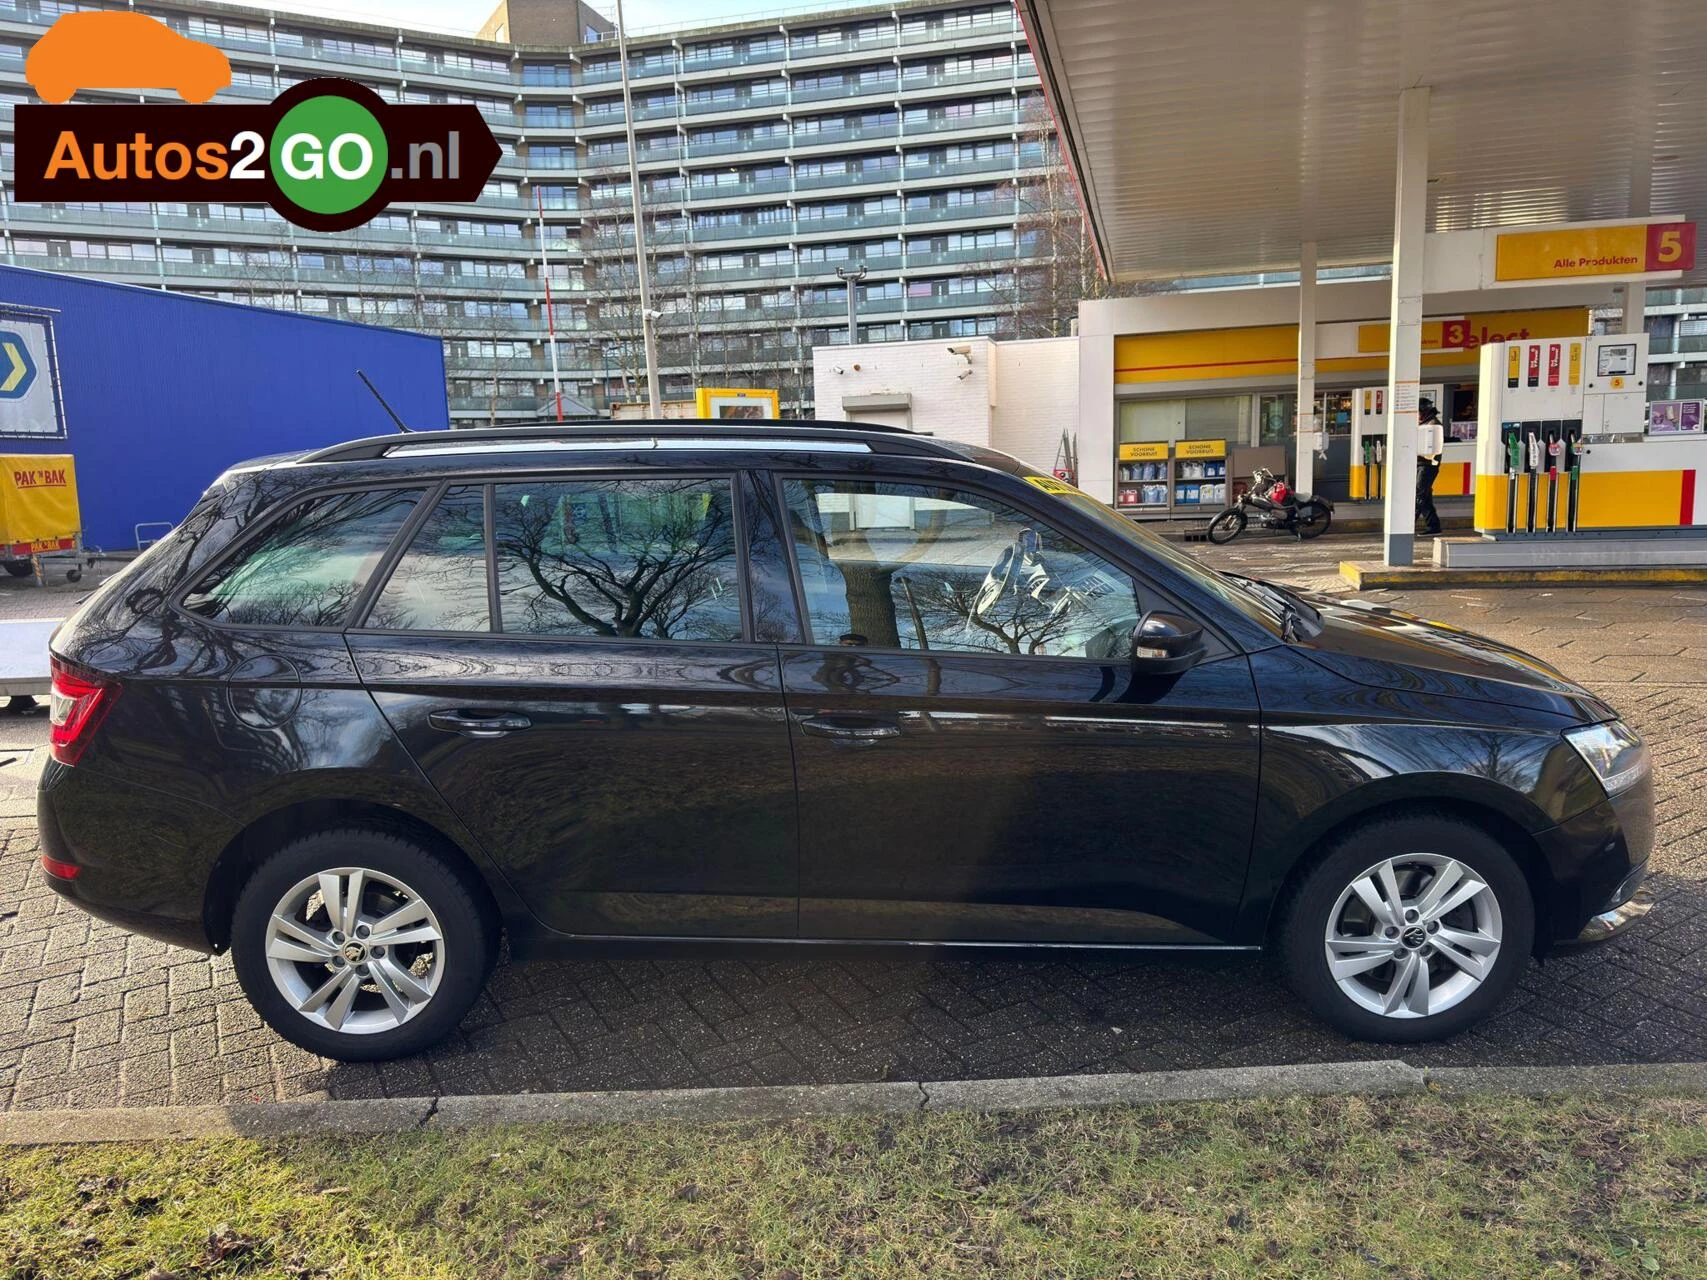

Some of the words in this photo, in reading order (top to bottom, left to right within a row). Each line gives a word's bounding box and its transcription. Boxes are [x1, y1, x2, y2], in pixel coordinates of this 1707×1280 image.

[1658, 231, 1682, 263] 5
[1554, 258, 1576, 268] Alle
[1579, 256, 1638, 266] Produkten
[1448, 325, 1464, 344] 3
[1465, 327, 1530, 349] elect
[14, 471, 36, 486] PAK
[45, 470, 66, 483] BAK
